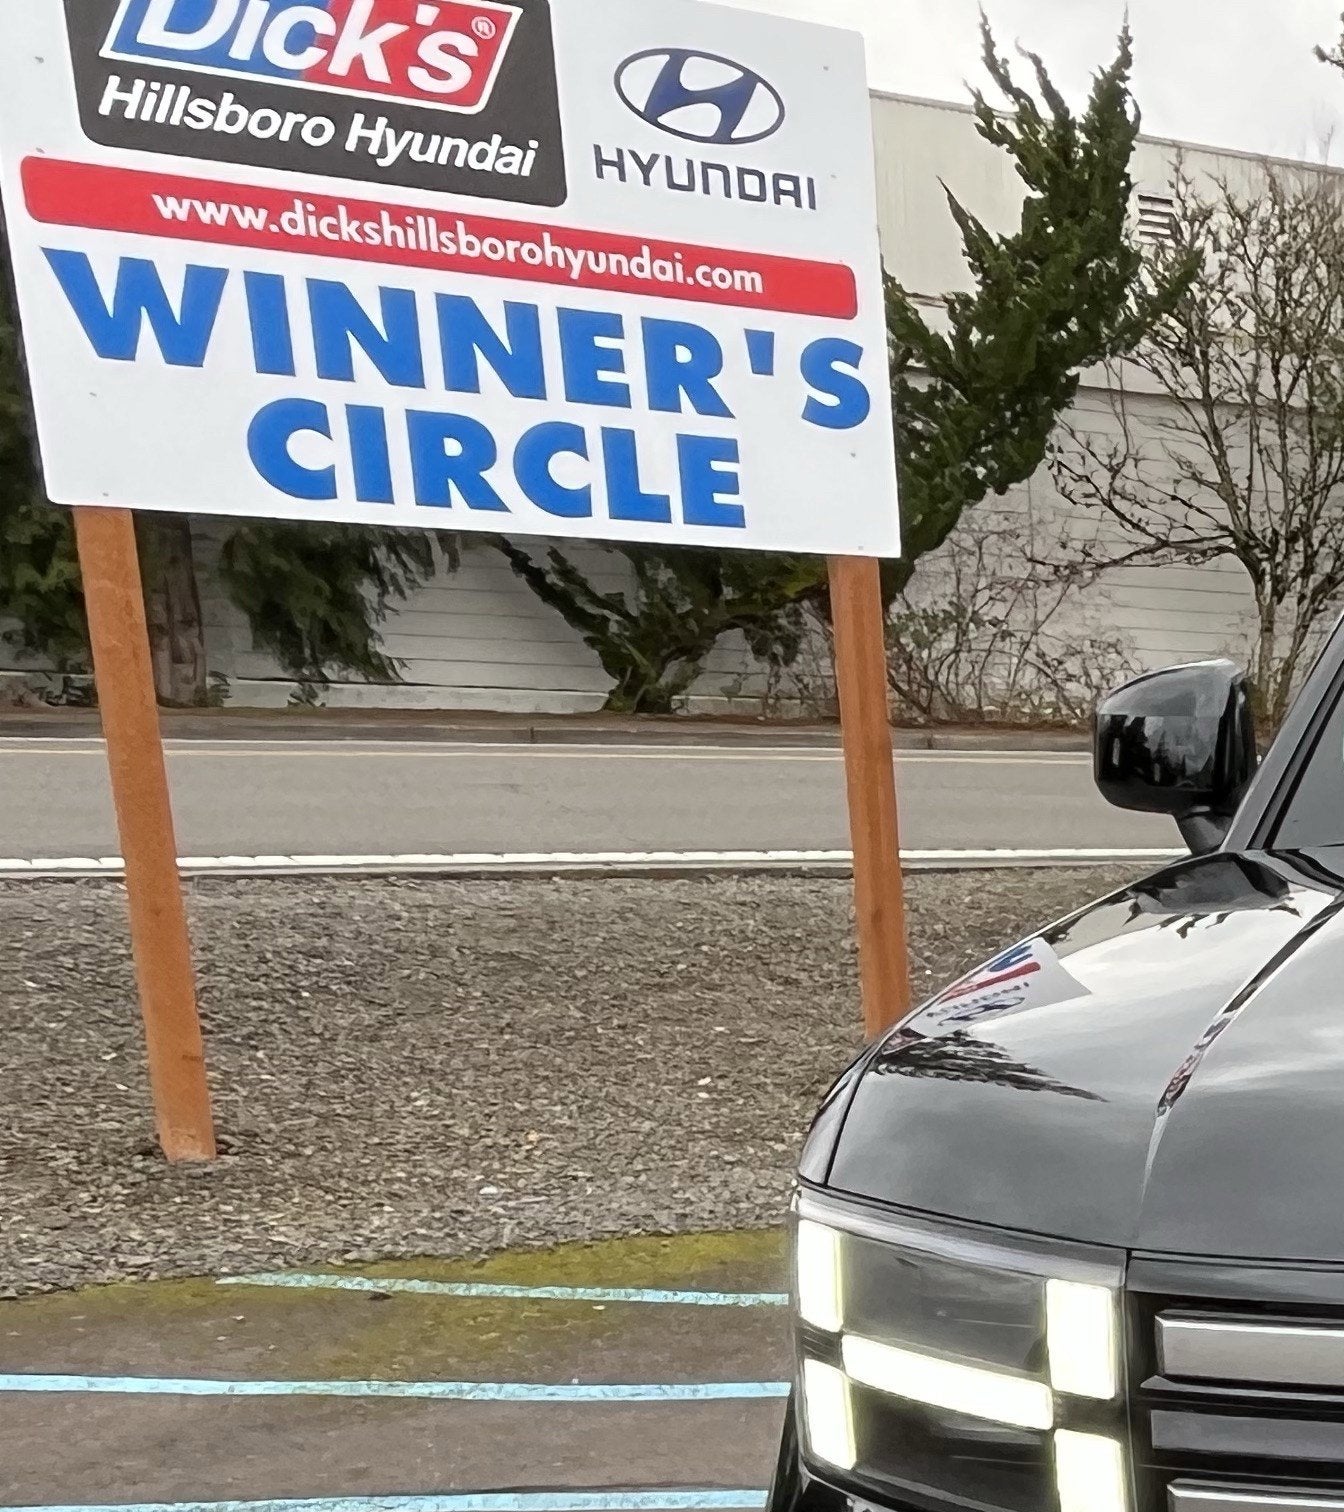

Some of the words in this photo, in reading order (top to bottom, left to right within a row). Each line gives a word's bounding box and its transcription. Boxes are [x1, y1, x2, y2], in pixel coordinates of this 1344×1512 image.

[99, 75, 336, 147] Hillsboro
[345, 112, 540, 178] Hyundai
[593, 144, 817, 211] HYUNDAI
[152, 193, 764, 294] www.dickshillsborohyundai.com
[41, 247, 872, 430] WINNER'S
[247, 397, 747, 530] CIRCLE
